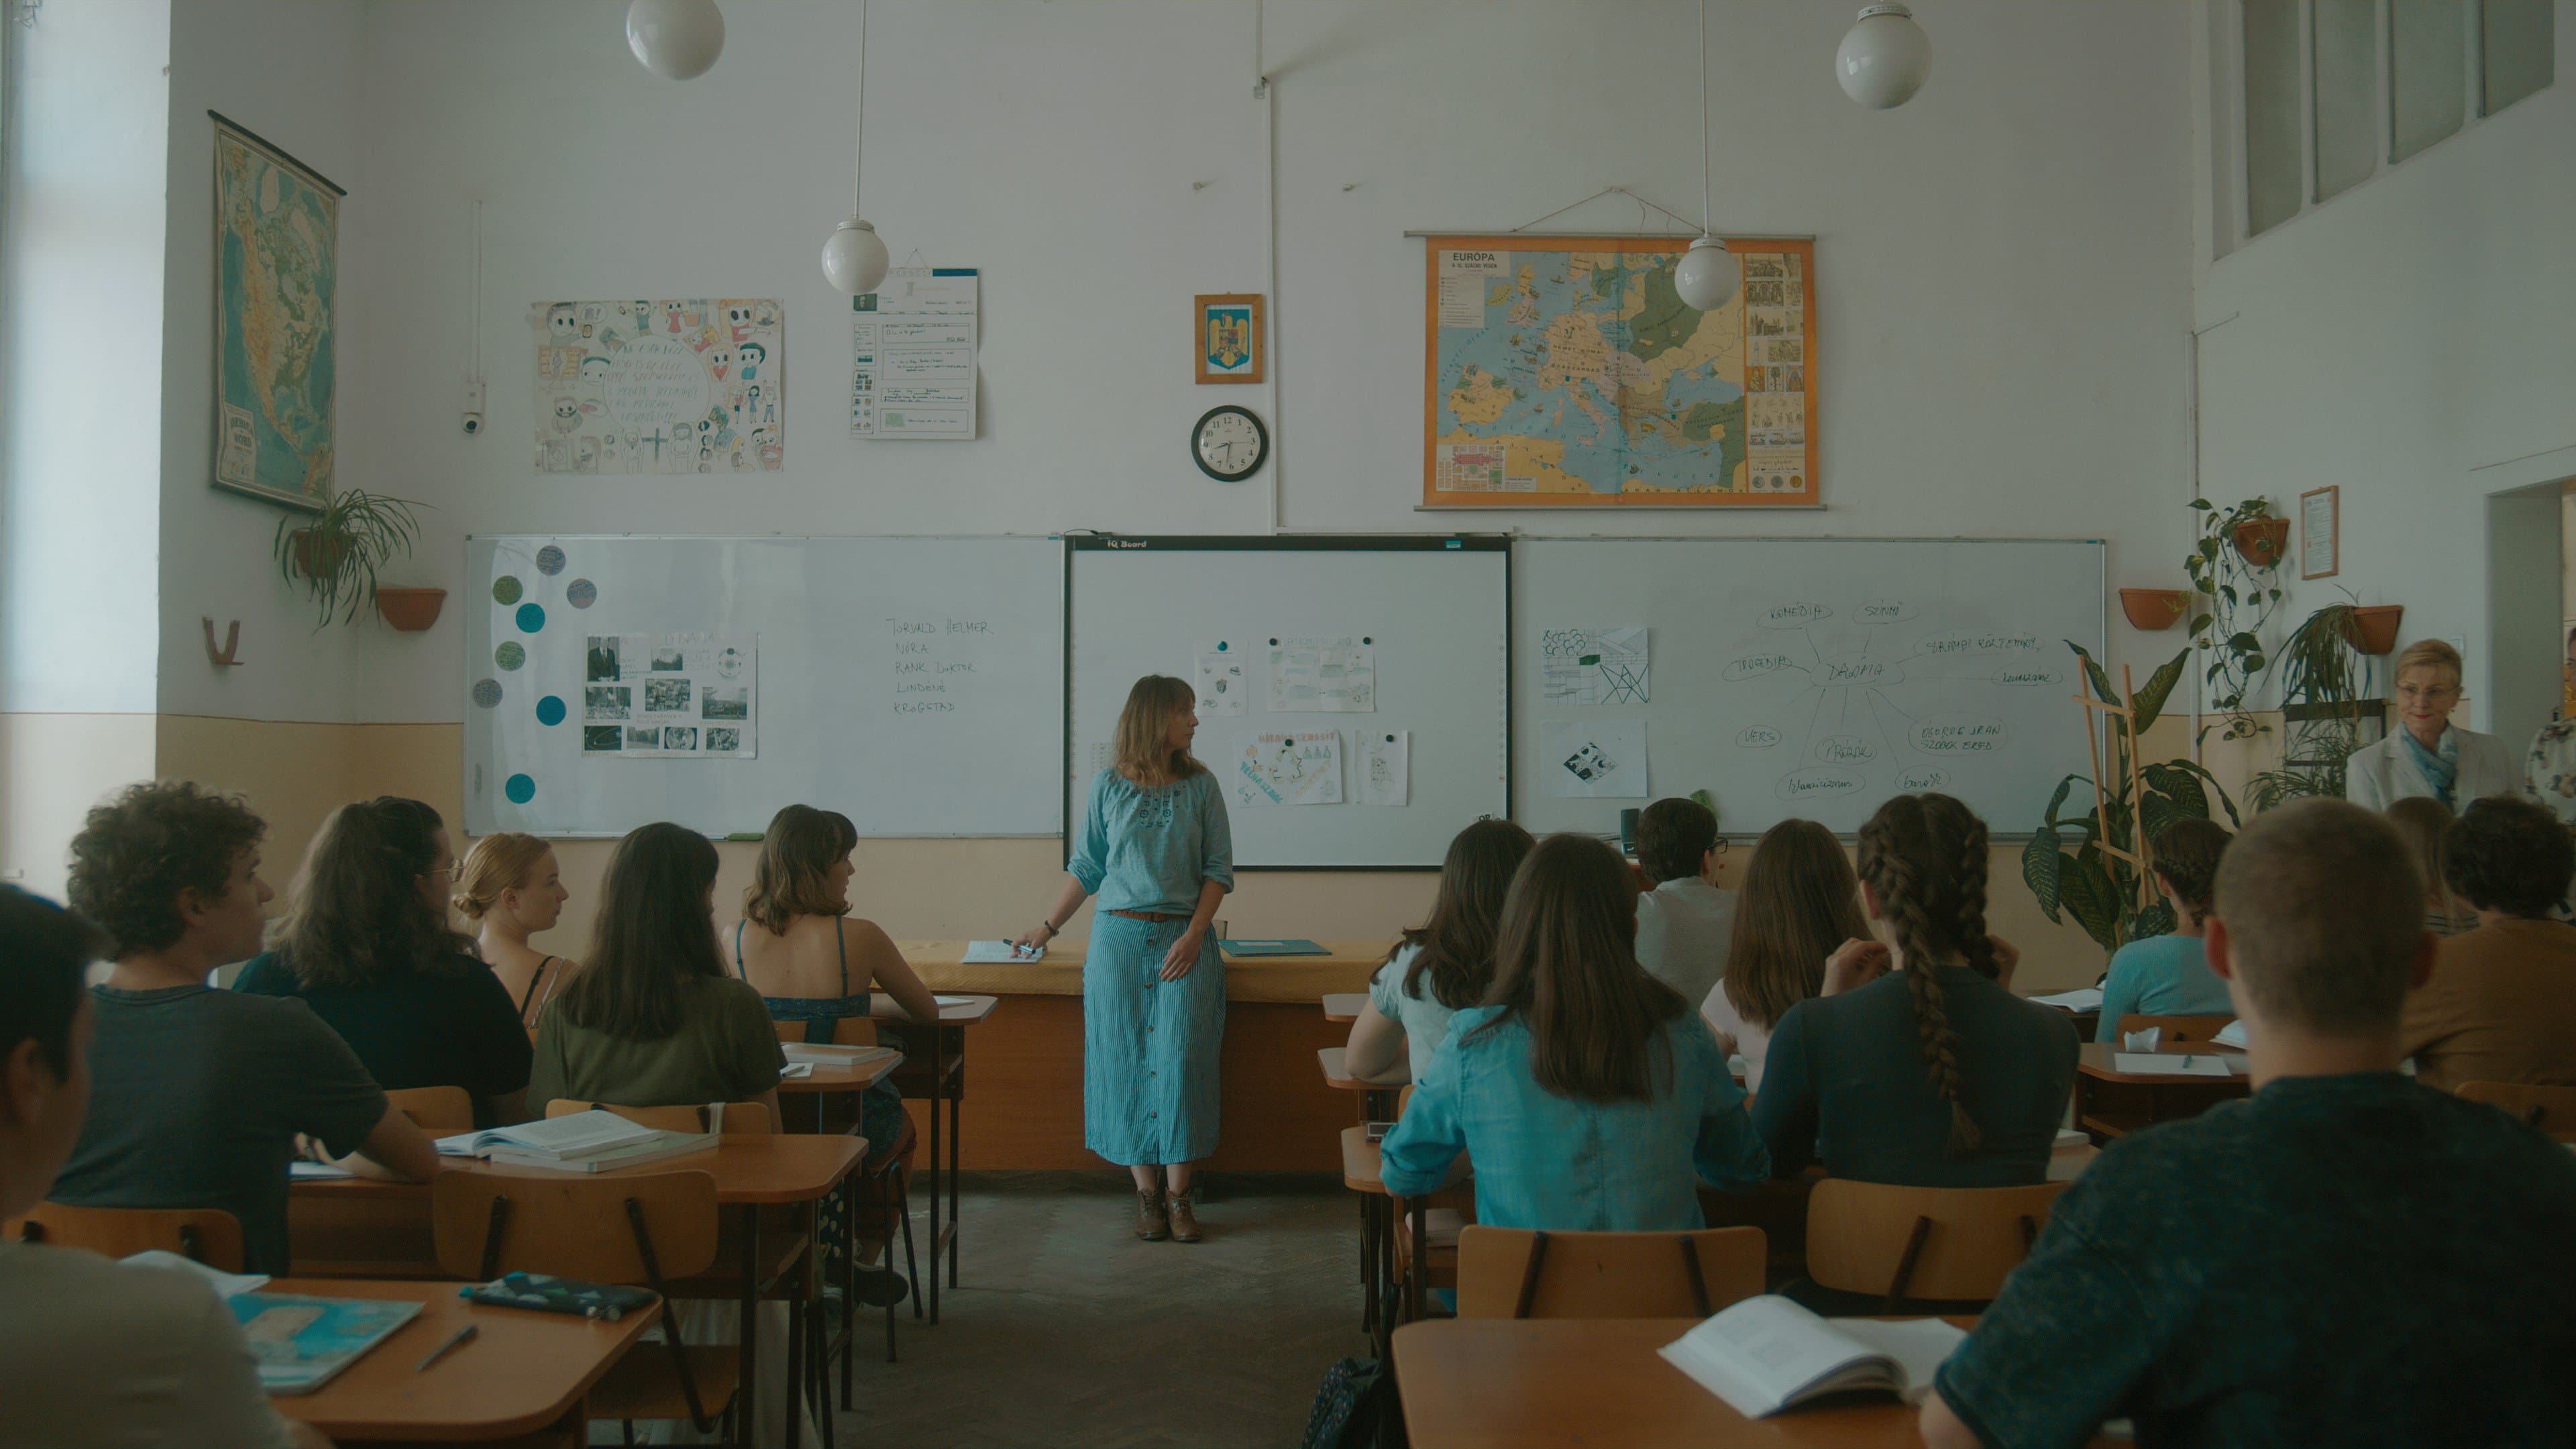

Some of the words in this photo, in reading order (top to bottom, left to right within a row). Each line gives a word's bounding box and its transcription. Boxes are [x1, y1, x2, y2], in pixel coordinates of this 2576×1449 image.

[1453, 252, 1495, 261] EURÓPA
[1120, 540, 1147, 548] Board
[945, 617, 994, 636] HELMER
[896, 641, 929, 655] NÓRA
[896, 661, 929, 675] RANK
